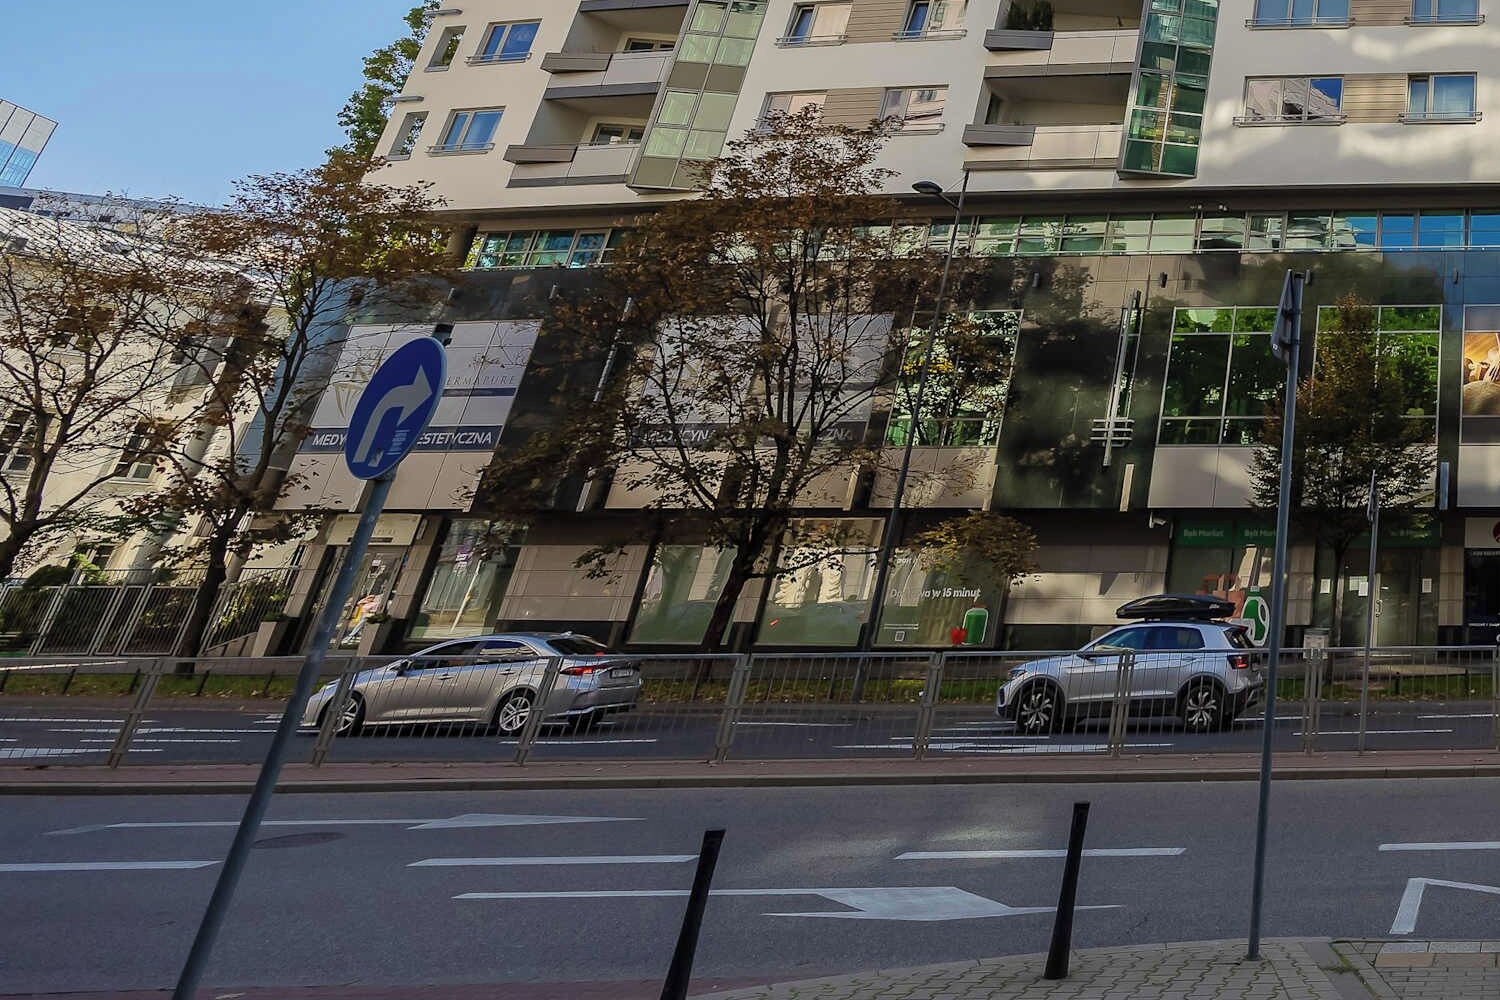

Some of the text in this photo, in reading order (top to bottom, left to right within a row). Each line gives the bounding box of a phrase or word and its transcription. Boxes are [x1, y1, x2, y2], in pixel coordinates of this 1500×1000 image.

[446, 375, 514, 386] ERMAPURE
[311, 433, 346, 446] MEDY
[942, 587, 952, 598] 15
[953, 587, 981, 599] minut
